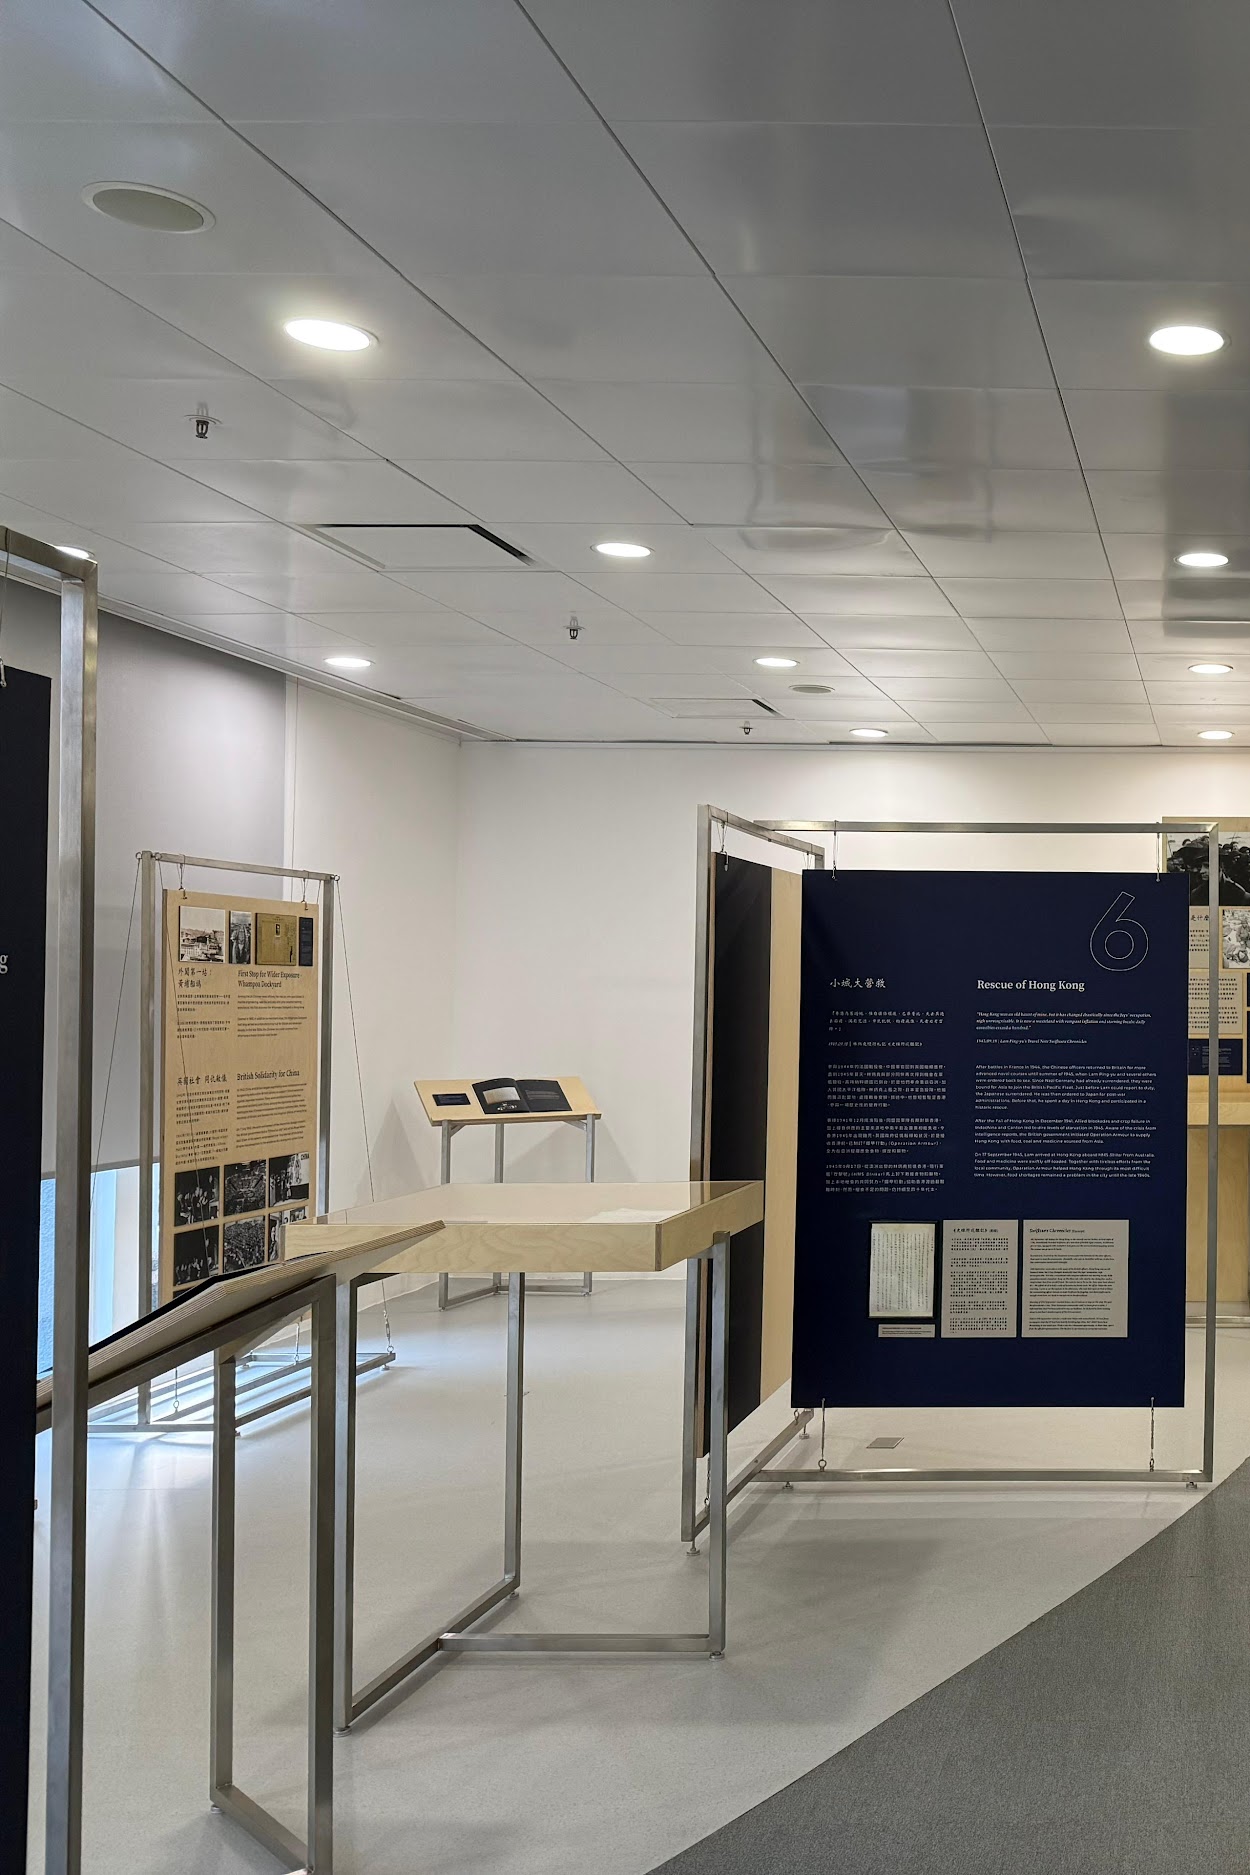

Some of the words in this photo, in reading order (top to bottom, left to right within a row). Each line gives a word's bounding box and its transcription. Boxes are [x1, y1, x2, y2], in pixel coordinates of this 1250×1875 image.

[1090, 891, 1149, 972] 6
[249, 970, 259, 980] Stop
[281, 971, 300, 980] Exposure
[238, 980, 260, 989] Whampoa
[261, 980, 282, 989] Dockyard
[977, 980, 1013, 990] Rescue
[1016, 979, 1027, 989] of
[1028, 980, 1056, 992] Hong
[1058, 980, 1085, 992] Kong
[254, 1071, 278, 1080] Solidarity
